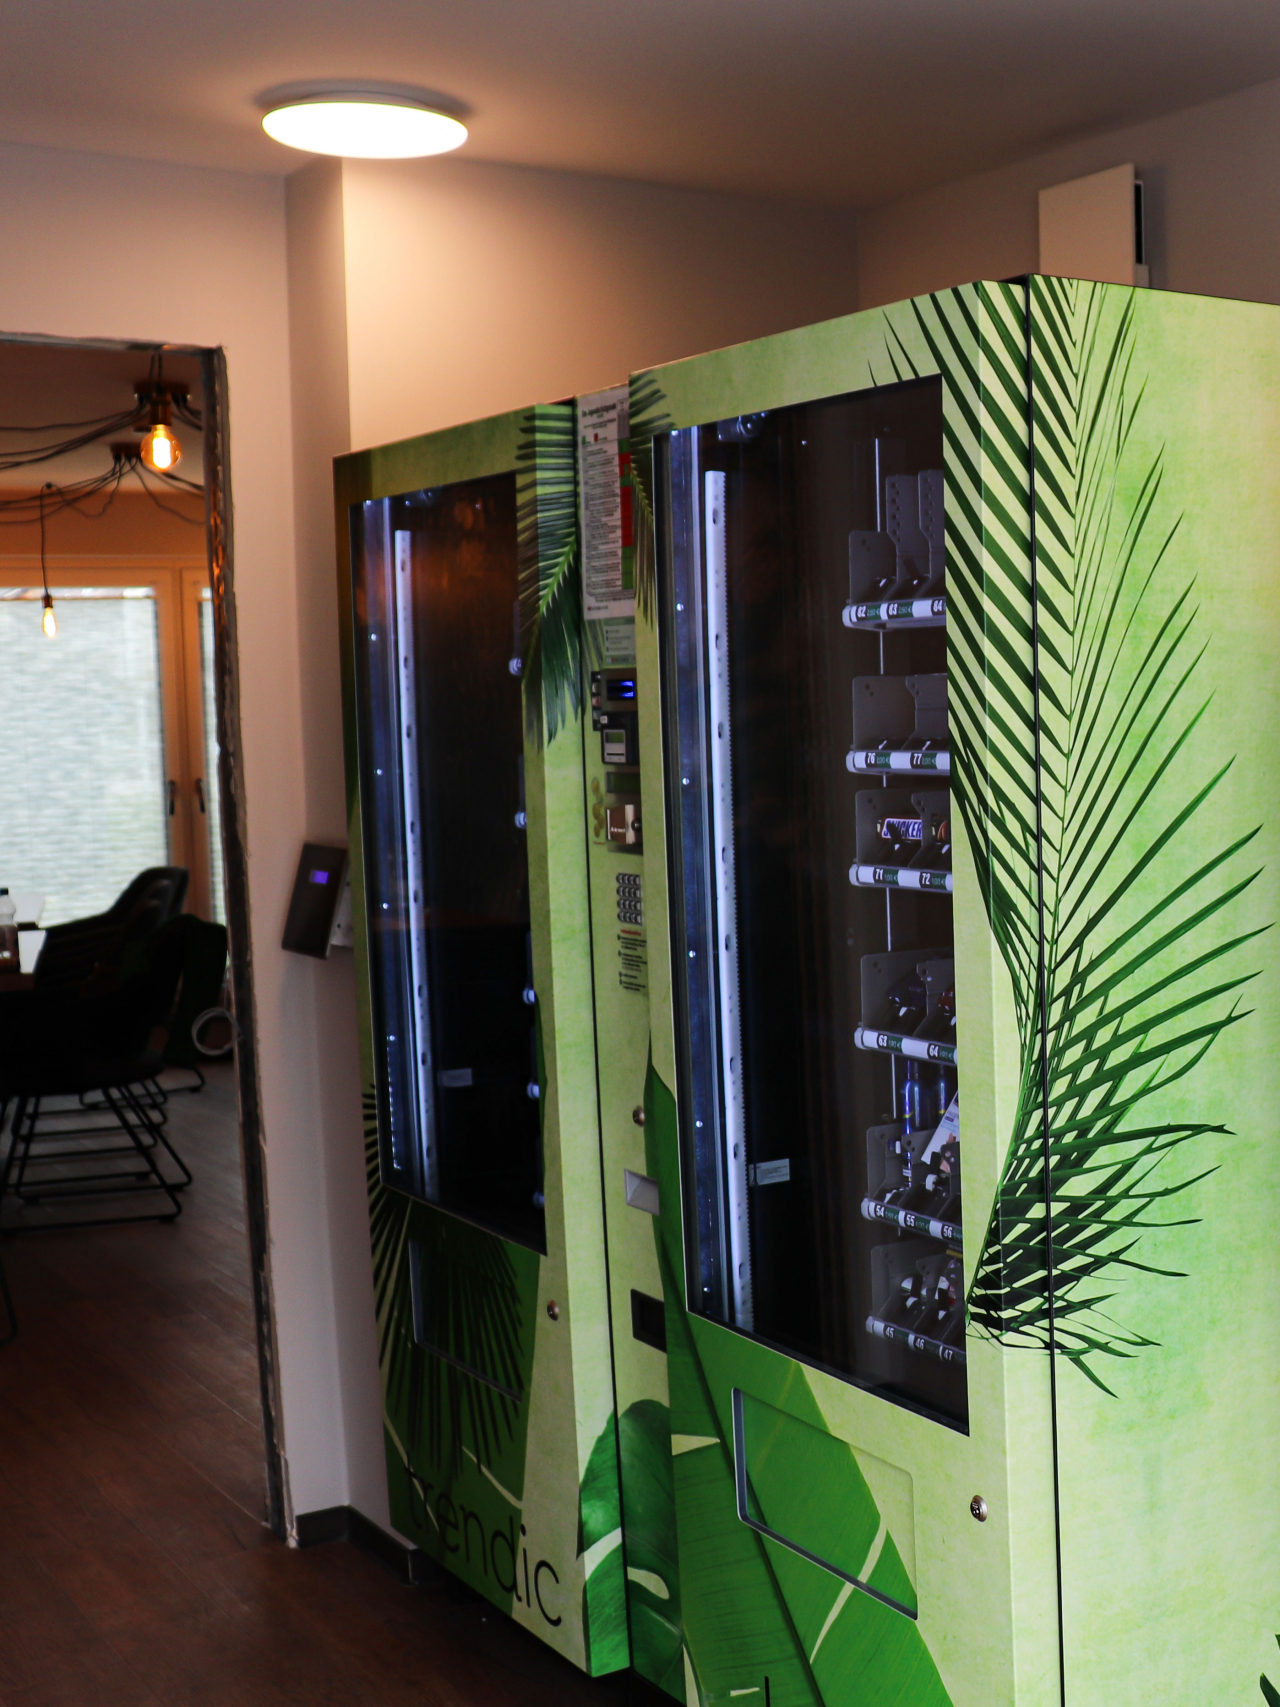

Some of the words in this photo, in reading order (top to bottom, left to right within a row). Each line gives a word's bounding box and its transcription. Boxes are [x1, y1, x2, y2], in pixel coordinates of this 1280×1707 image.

[857, 605, 867, 618] 82
[888, 603, 898, 616] 83
[933, 599, 943, 612] 84
[867, 752, 876, 764] 76
[913, 753, 922, 765] 77
[875, 868, 884, 880] 71
[922, 873, 931, 885] 72
[878, 1034, 888, 1047] 63
[929, 1044, 939, 1057] 64
[875, 1205, 885, 1218] 54
[906, 1214, 916, 1227] 55
[943, 1225, 953, 1238] 56
[885, 1326, 895, 1339] 45
[915, 1338, 925, 1350] 46
[943, 1349, 954, 1360] 47
[404, 1451, 562, 1628] trendic
